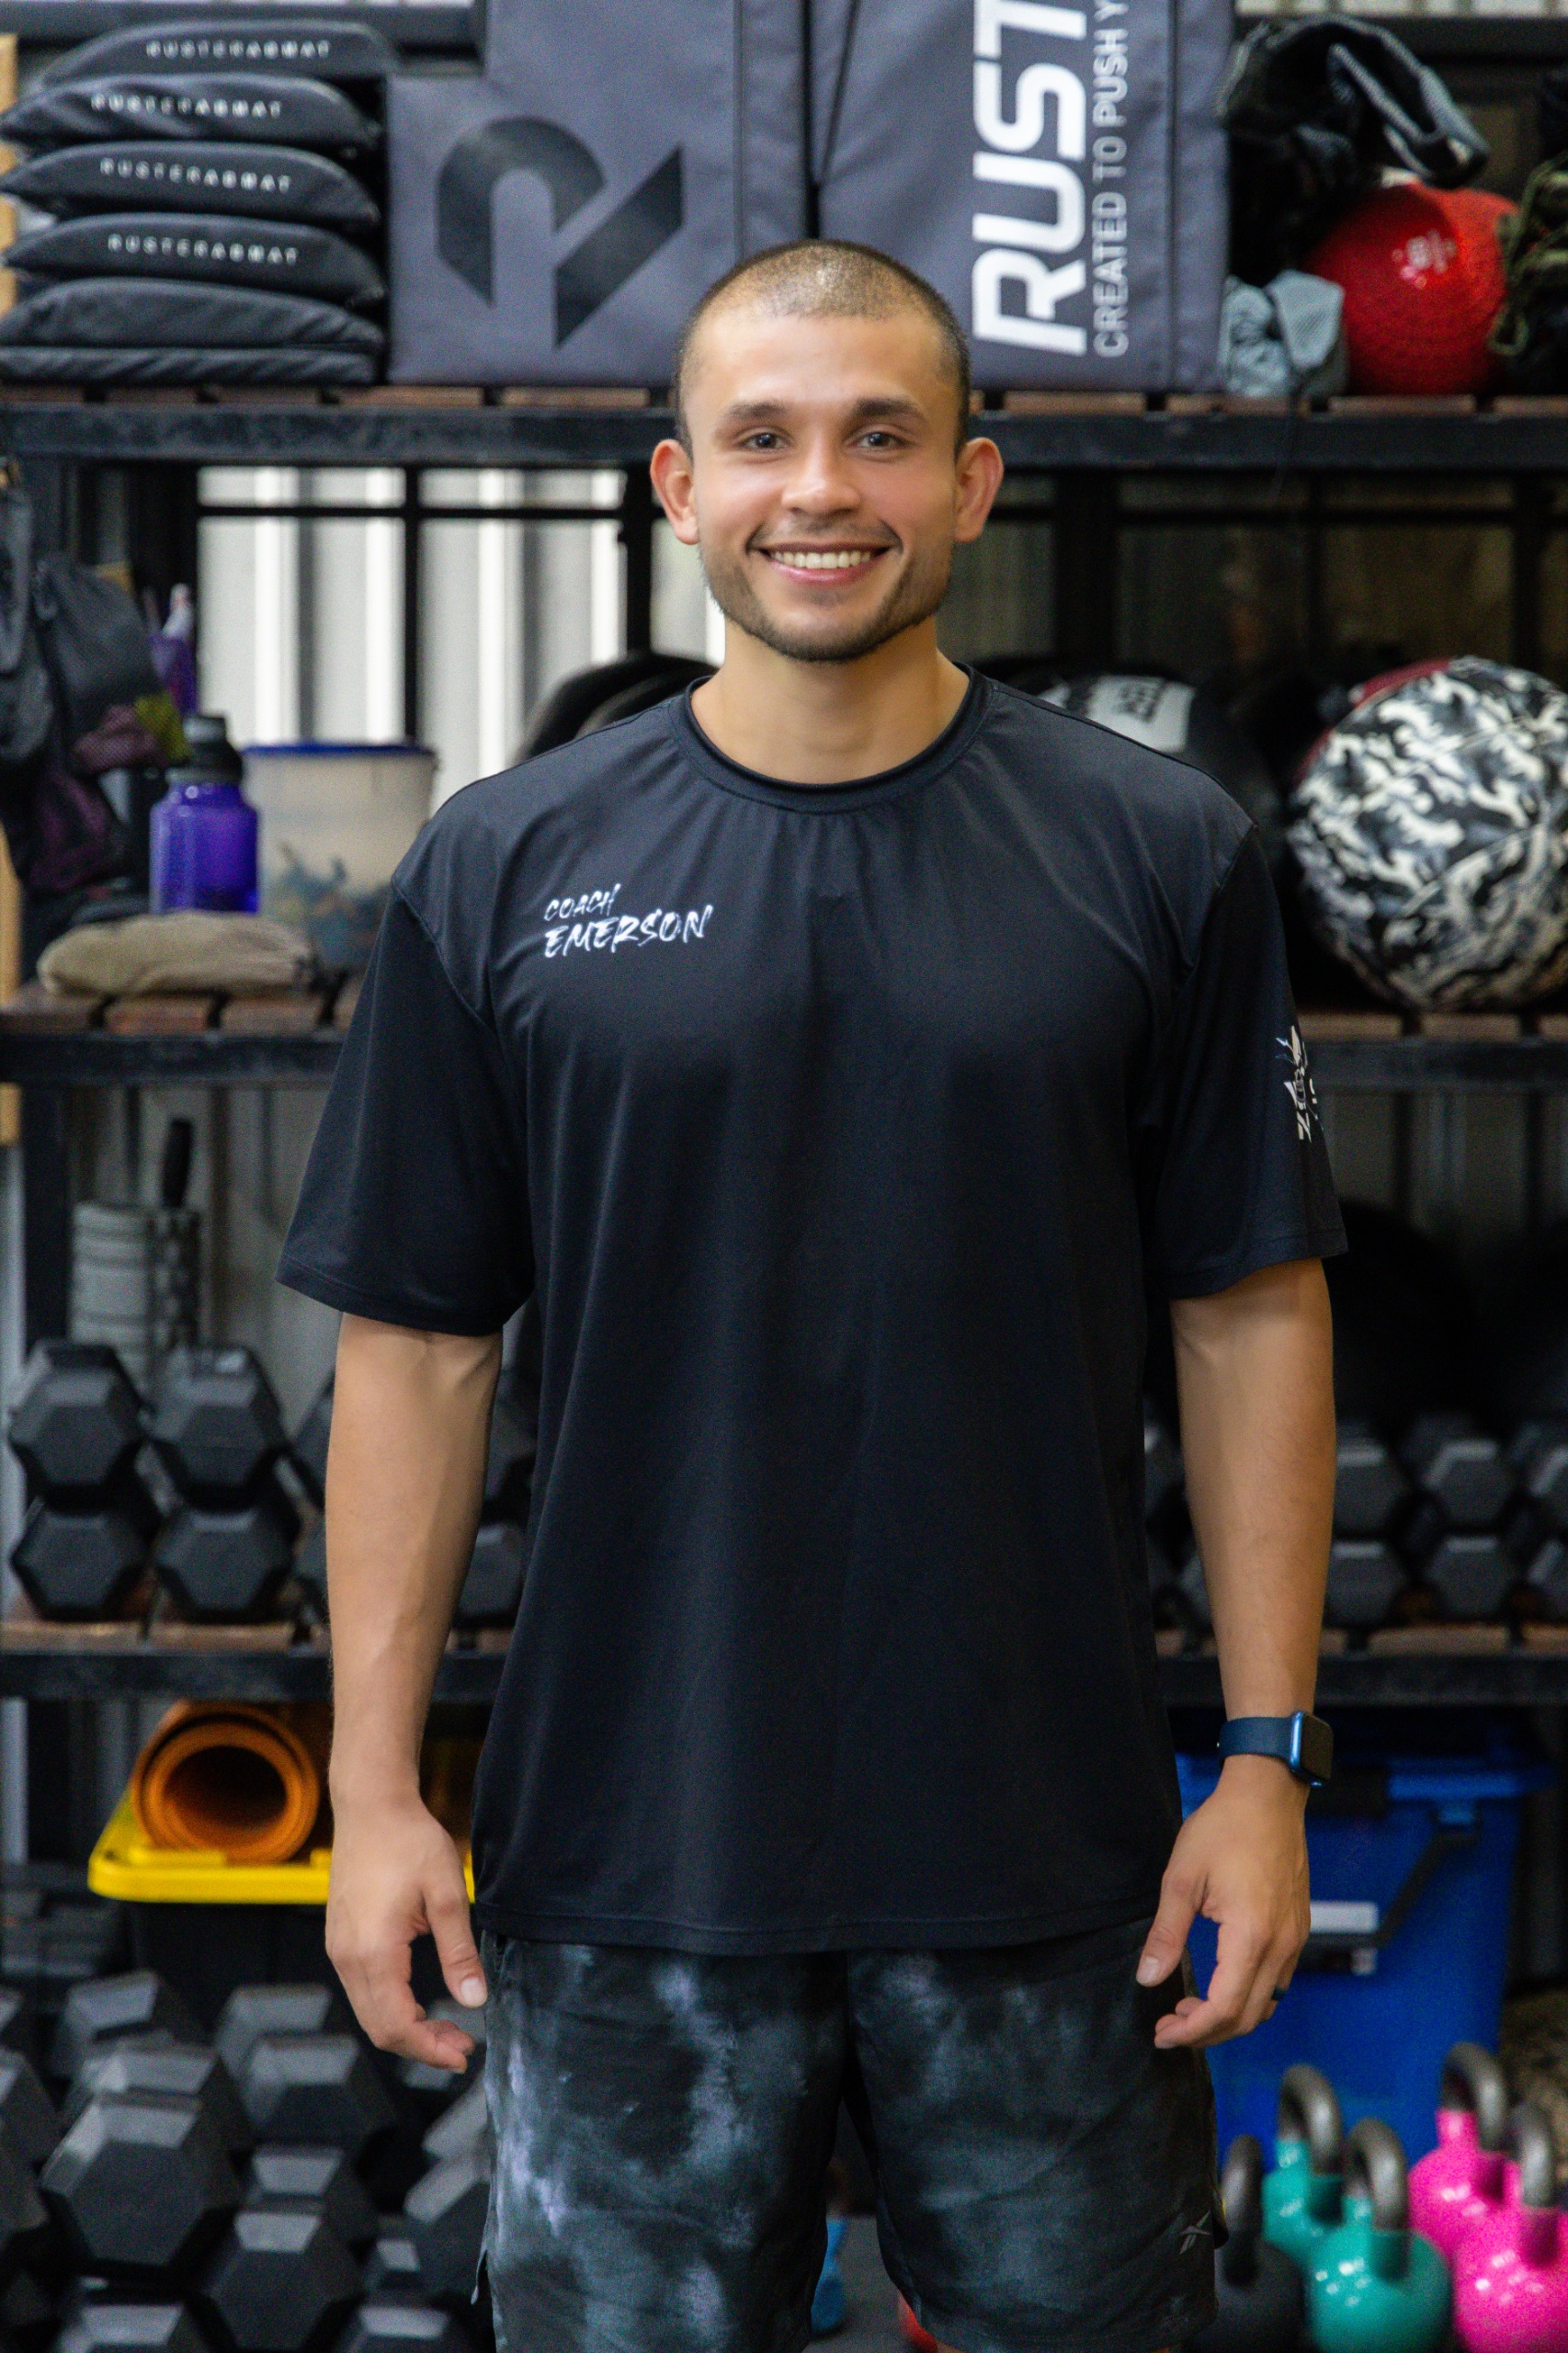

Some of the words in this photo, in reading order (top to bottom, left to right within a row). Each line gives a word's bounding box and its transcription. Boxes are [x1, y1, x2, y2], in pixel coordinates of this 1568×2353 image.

[1092, 28, 1129, 128] PUSH
[1092, 135, 1129, 182] TO
[1092, 191, 1130, 358] CREATED
[544, 883, 621, 921] COACH
[544, 904, 714, 958] EMERSON
